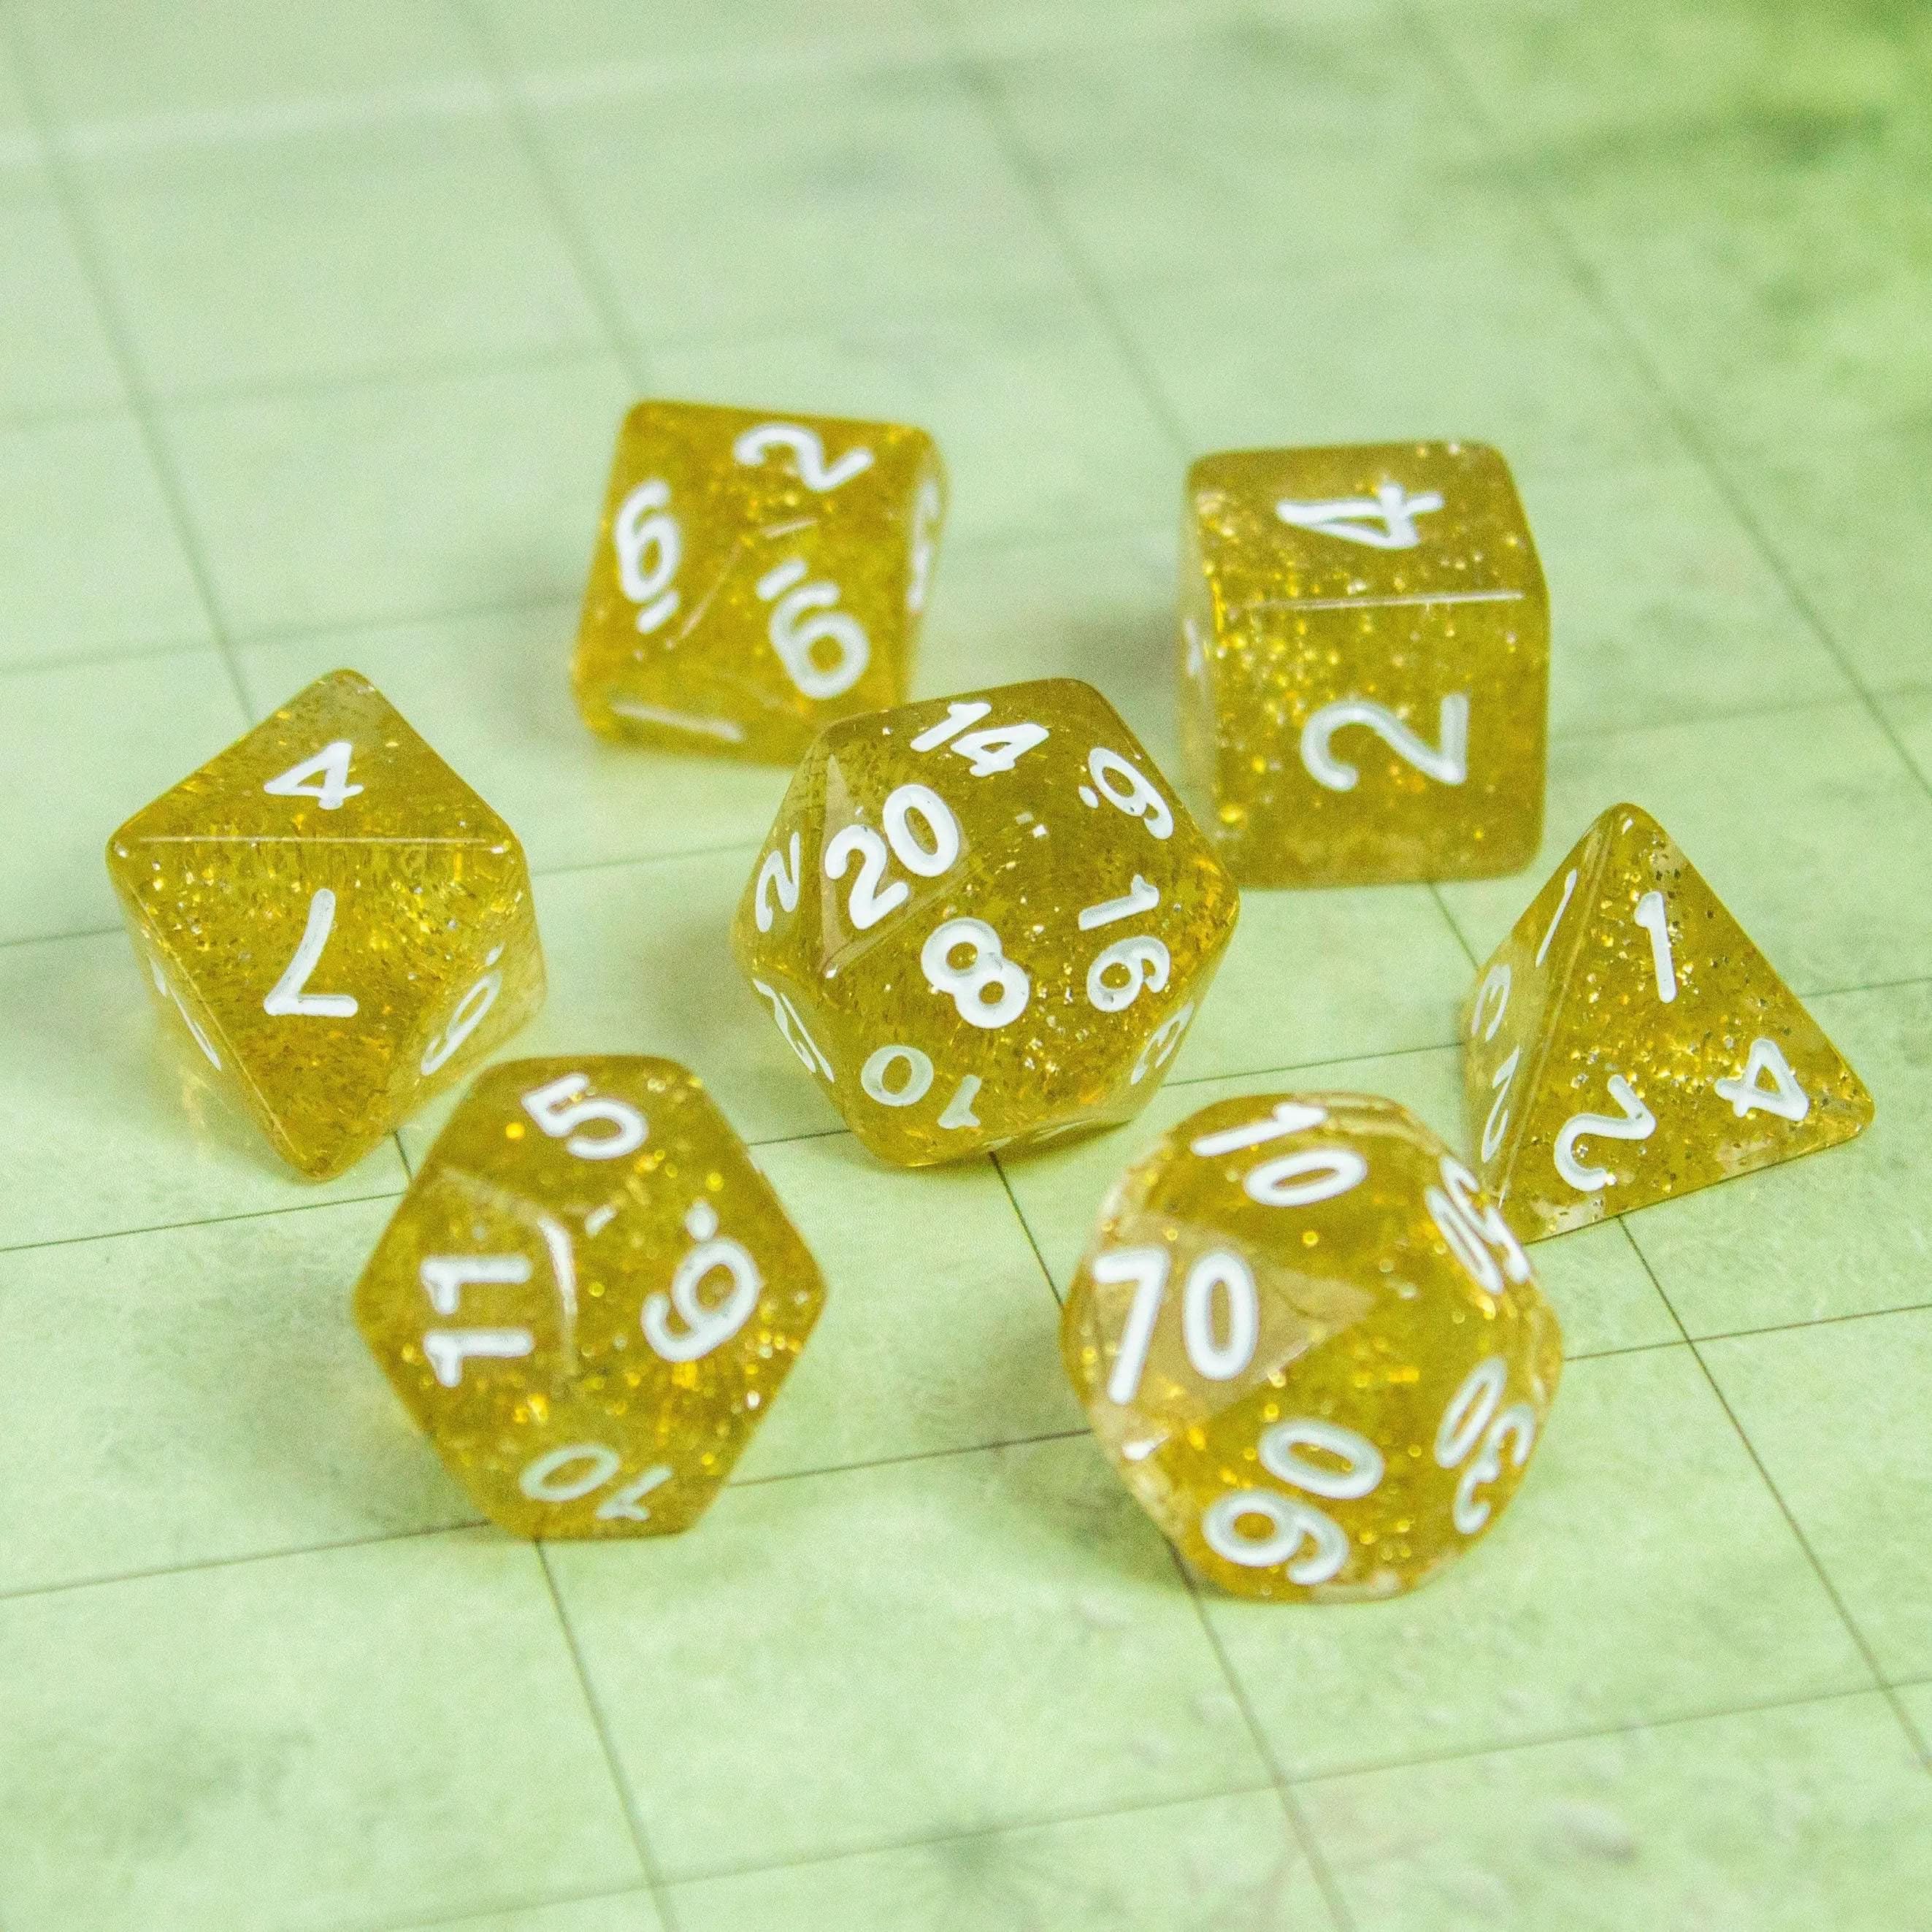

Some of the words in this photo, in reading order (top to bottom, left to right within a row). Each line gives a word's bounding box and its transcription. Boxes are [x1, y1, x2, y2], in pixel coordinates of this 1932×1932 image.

[735, 423, 873, 491] 2
[1276, 480, 1444, 549] 4
[264, 740, 363, 810] 4
[911, 702, 1049, 776] 14
[1302, 694, 1468, 790] 2
[824, 784, 961, 929] 20
[264, 889, 358, 1017] 7
[921, 918, 1030, 1028] 8
[1079, 875, 1170, 1012] 16
[1634, 891, 1676, 1003] 1
[521, 1074, 648, 1159] 5
[862, 1046, 981, 1129] 10
[1555, 1075, 1657, 1192] 2
[1715, 1038, 1809, 1121] 4
[1190, 1103, 1368, 1207] 10
[421, 1256, 533, 1387] 11
[1092, 1246, 1260, 1406] 70
[1433, 1357, 1536, 1534] 30
[1202, 1420, 1384, 1585] 90
